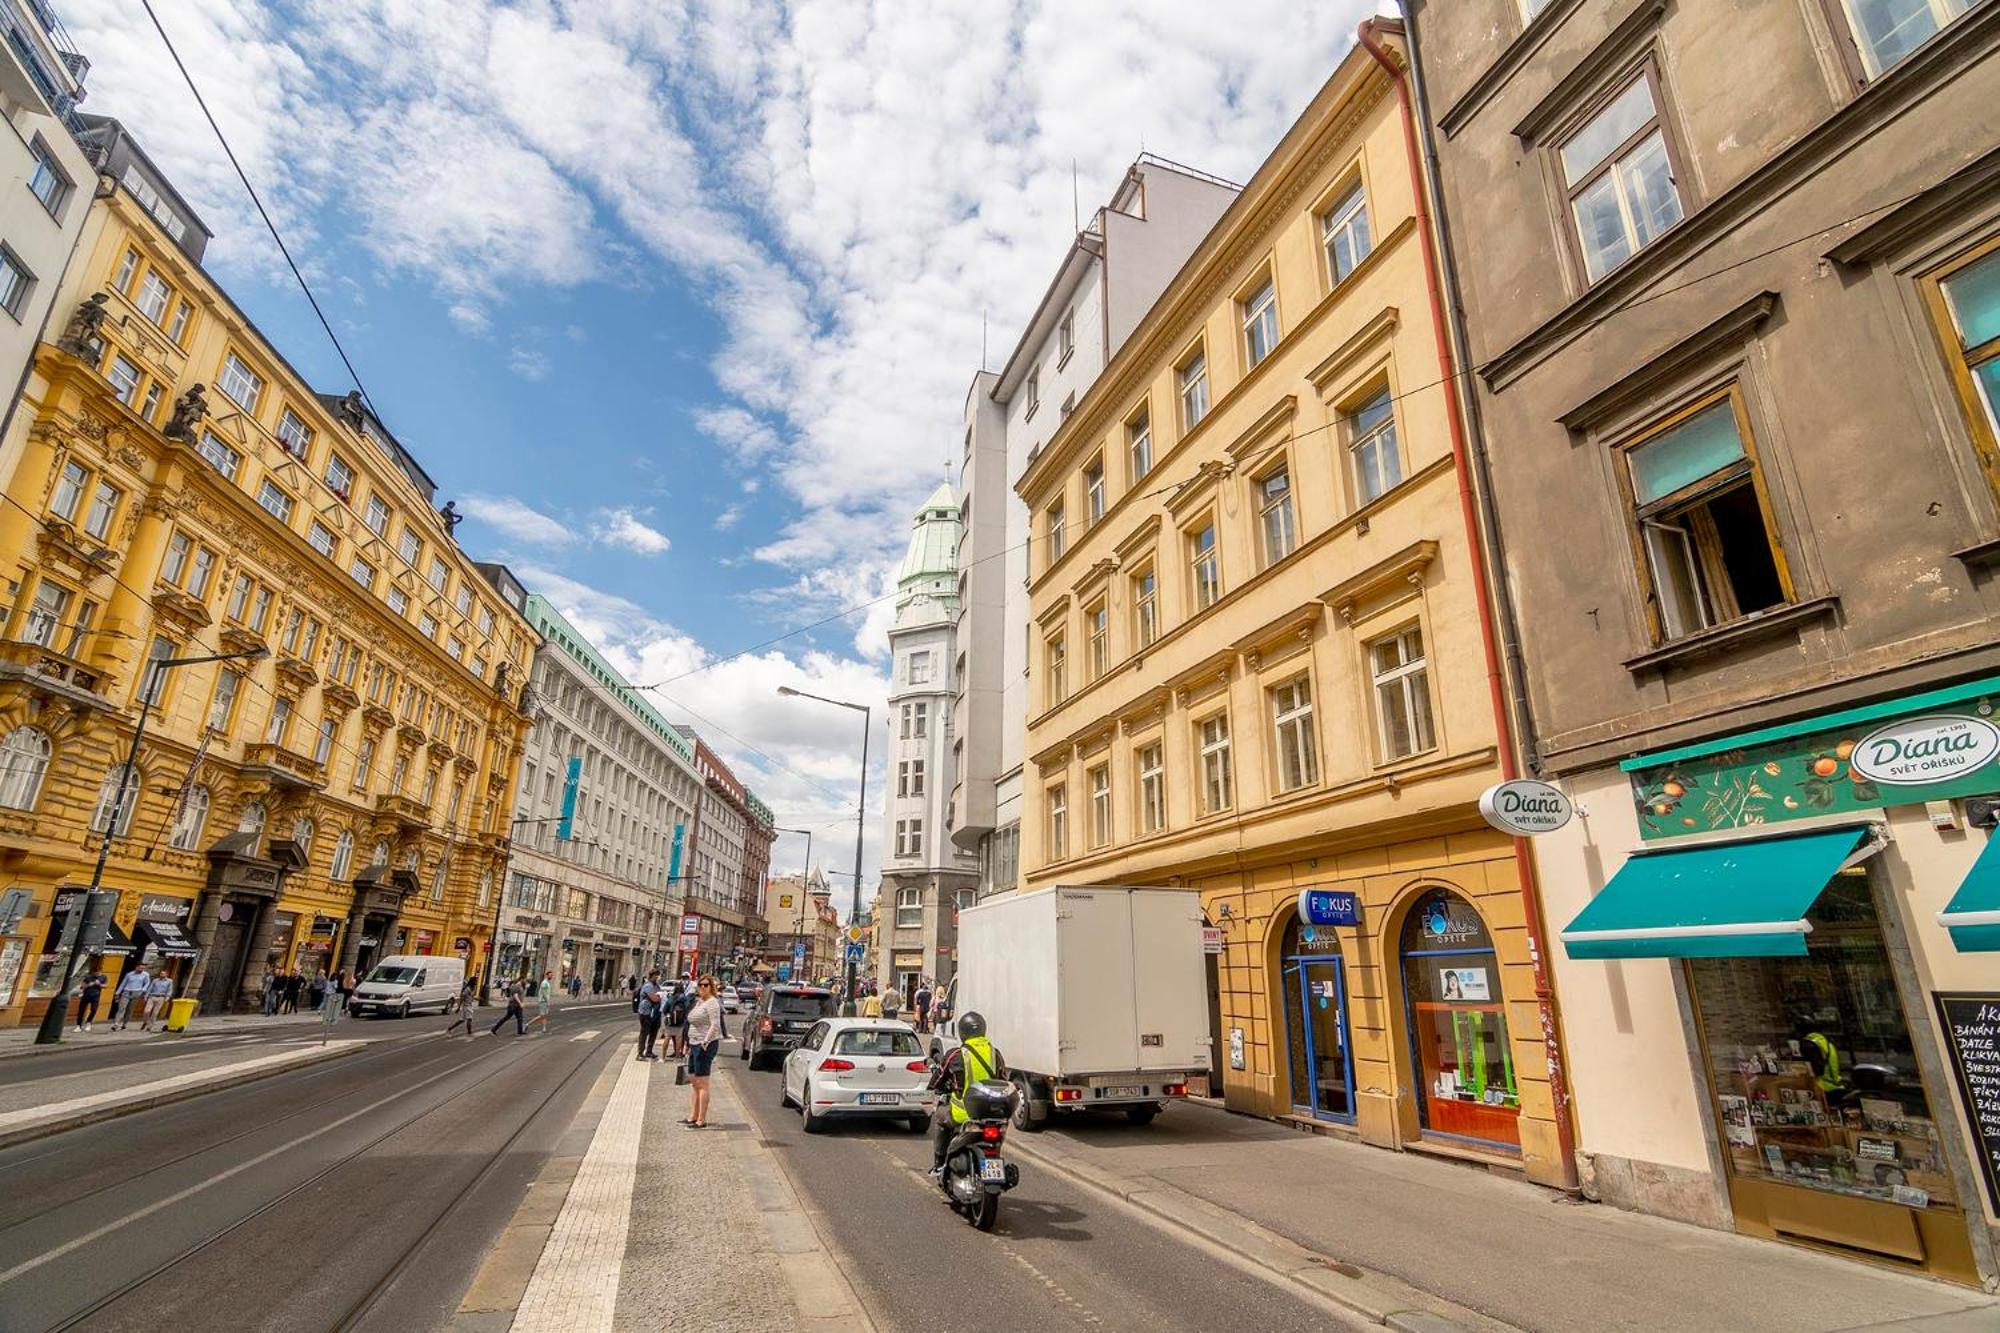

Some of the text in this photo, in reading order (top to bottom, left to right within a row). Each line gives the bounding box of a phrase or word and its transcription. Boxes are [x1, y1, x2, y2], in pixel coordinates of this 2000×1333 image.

[1870, 731, 1978, 766] Diana
[1889, 763, 1917, 775] SVĚT
[1501, 790, 1563, 814] Diana
[1311, 896, 1352, 912] FOKUS
[1976, 1004, 2000, 1022] AK
[1954, 1023, 1994, 1036] BANÁN
[1957, 1038, 1993, 1050] DATLE
[1968, 1073, 2000, 1086] ROZIN
